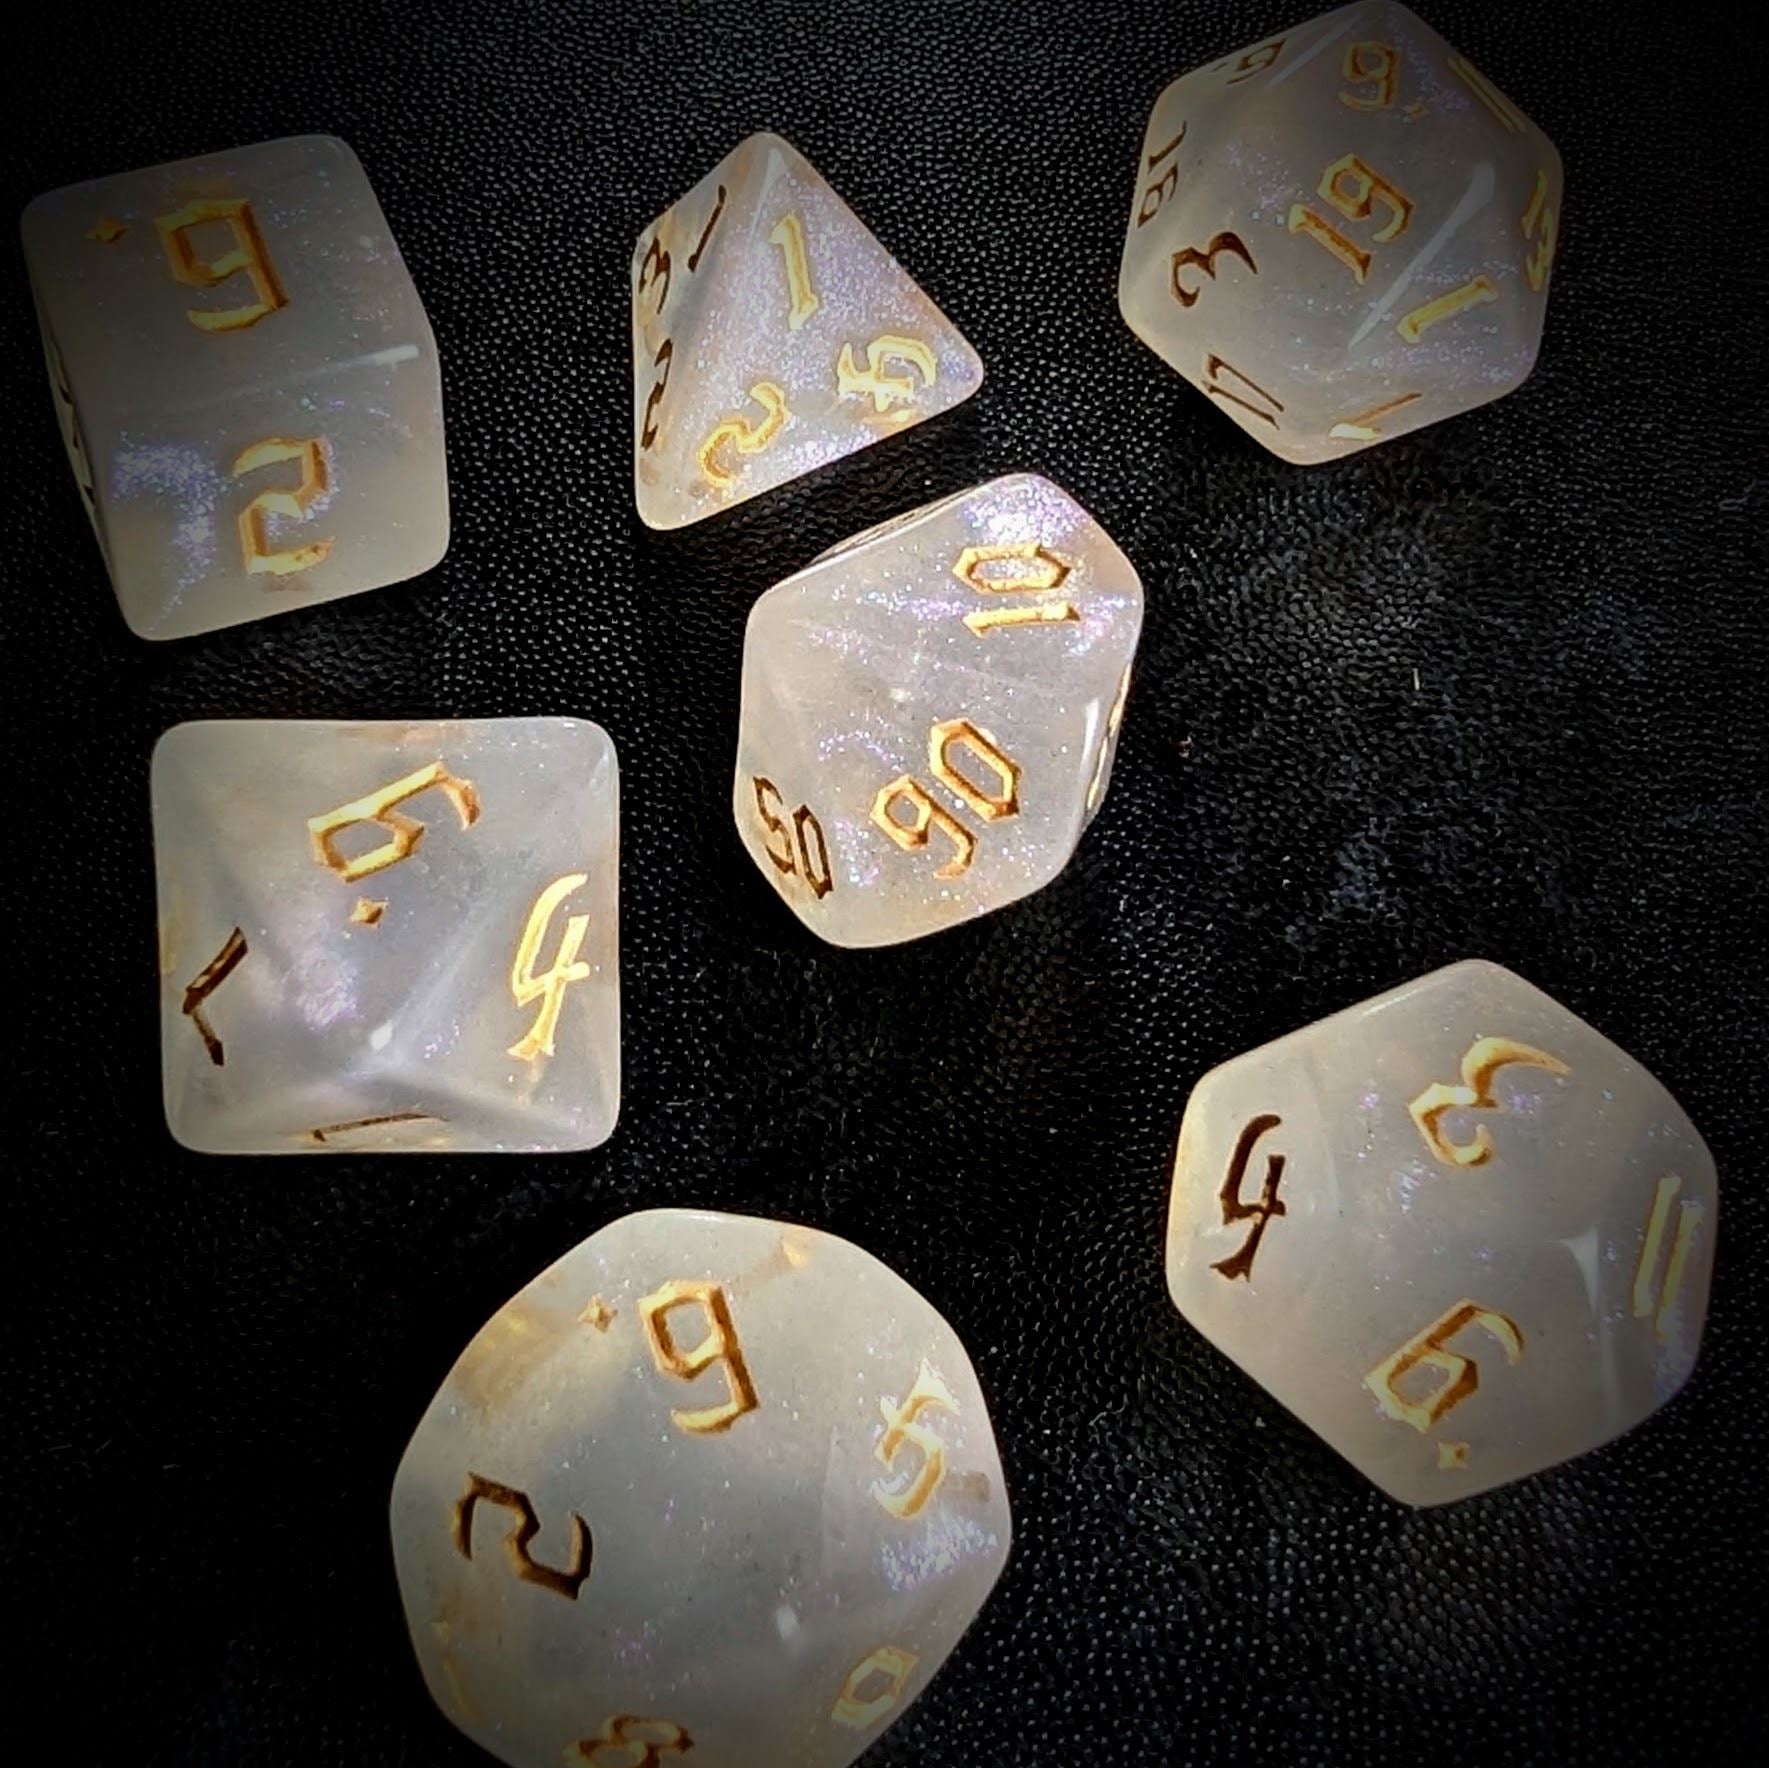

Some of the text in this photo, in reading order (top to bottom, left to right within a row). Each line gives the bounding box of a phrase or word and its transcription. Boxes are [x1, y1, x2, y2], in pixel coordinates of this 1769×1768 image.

[637, 235, 673, 315] 3
[687, 183, 728, 273] 1
[769, 210, 820, 331] 1
[1169, 231, 1258, 310] 3
[1287, 152, 1416, 287] 19
[1397, 274, 1500, 345] 1
[699, 380, 792, 489] 2
[231, 436, 337, 577] 2
[951, 542, 1082, 638] 10
[868, 716, 1025, 880] 90
[506, 871, 591, 1062] 4
[1407, 1034, 1573, 1167] 3
[1208, 1112, 1287, 1283] 4
[451, 1470, 595, 1600] 2
